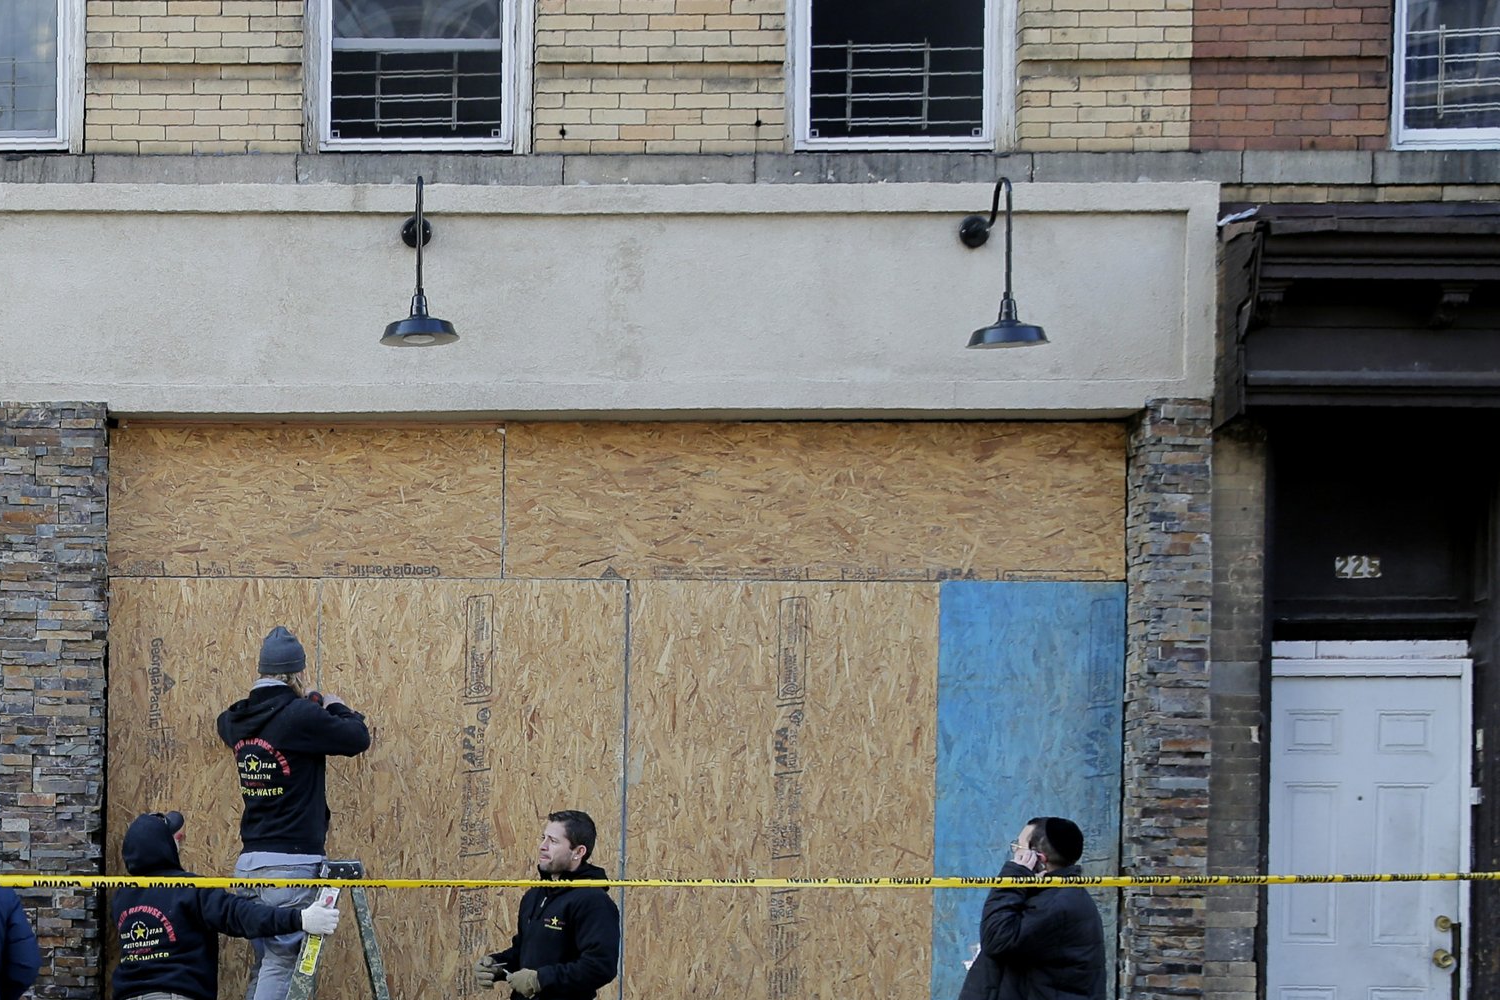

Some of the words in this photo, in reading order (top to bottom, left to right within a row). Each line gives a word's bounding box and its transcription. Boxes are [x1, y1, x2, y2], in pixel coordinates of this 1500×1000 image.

[1335, 555, 1381, 578] 225
[462, 725, 476, 767] APA
[774, 726, 788, 767] APA
